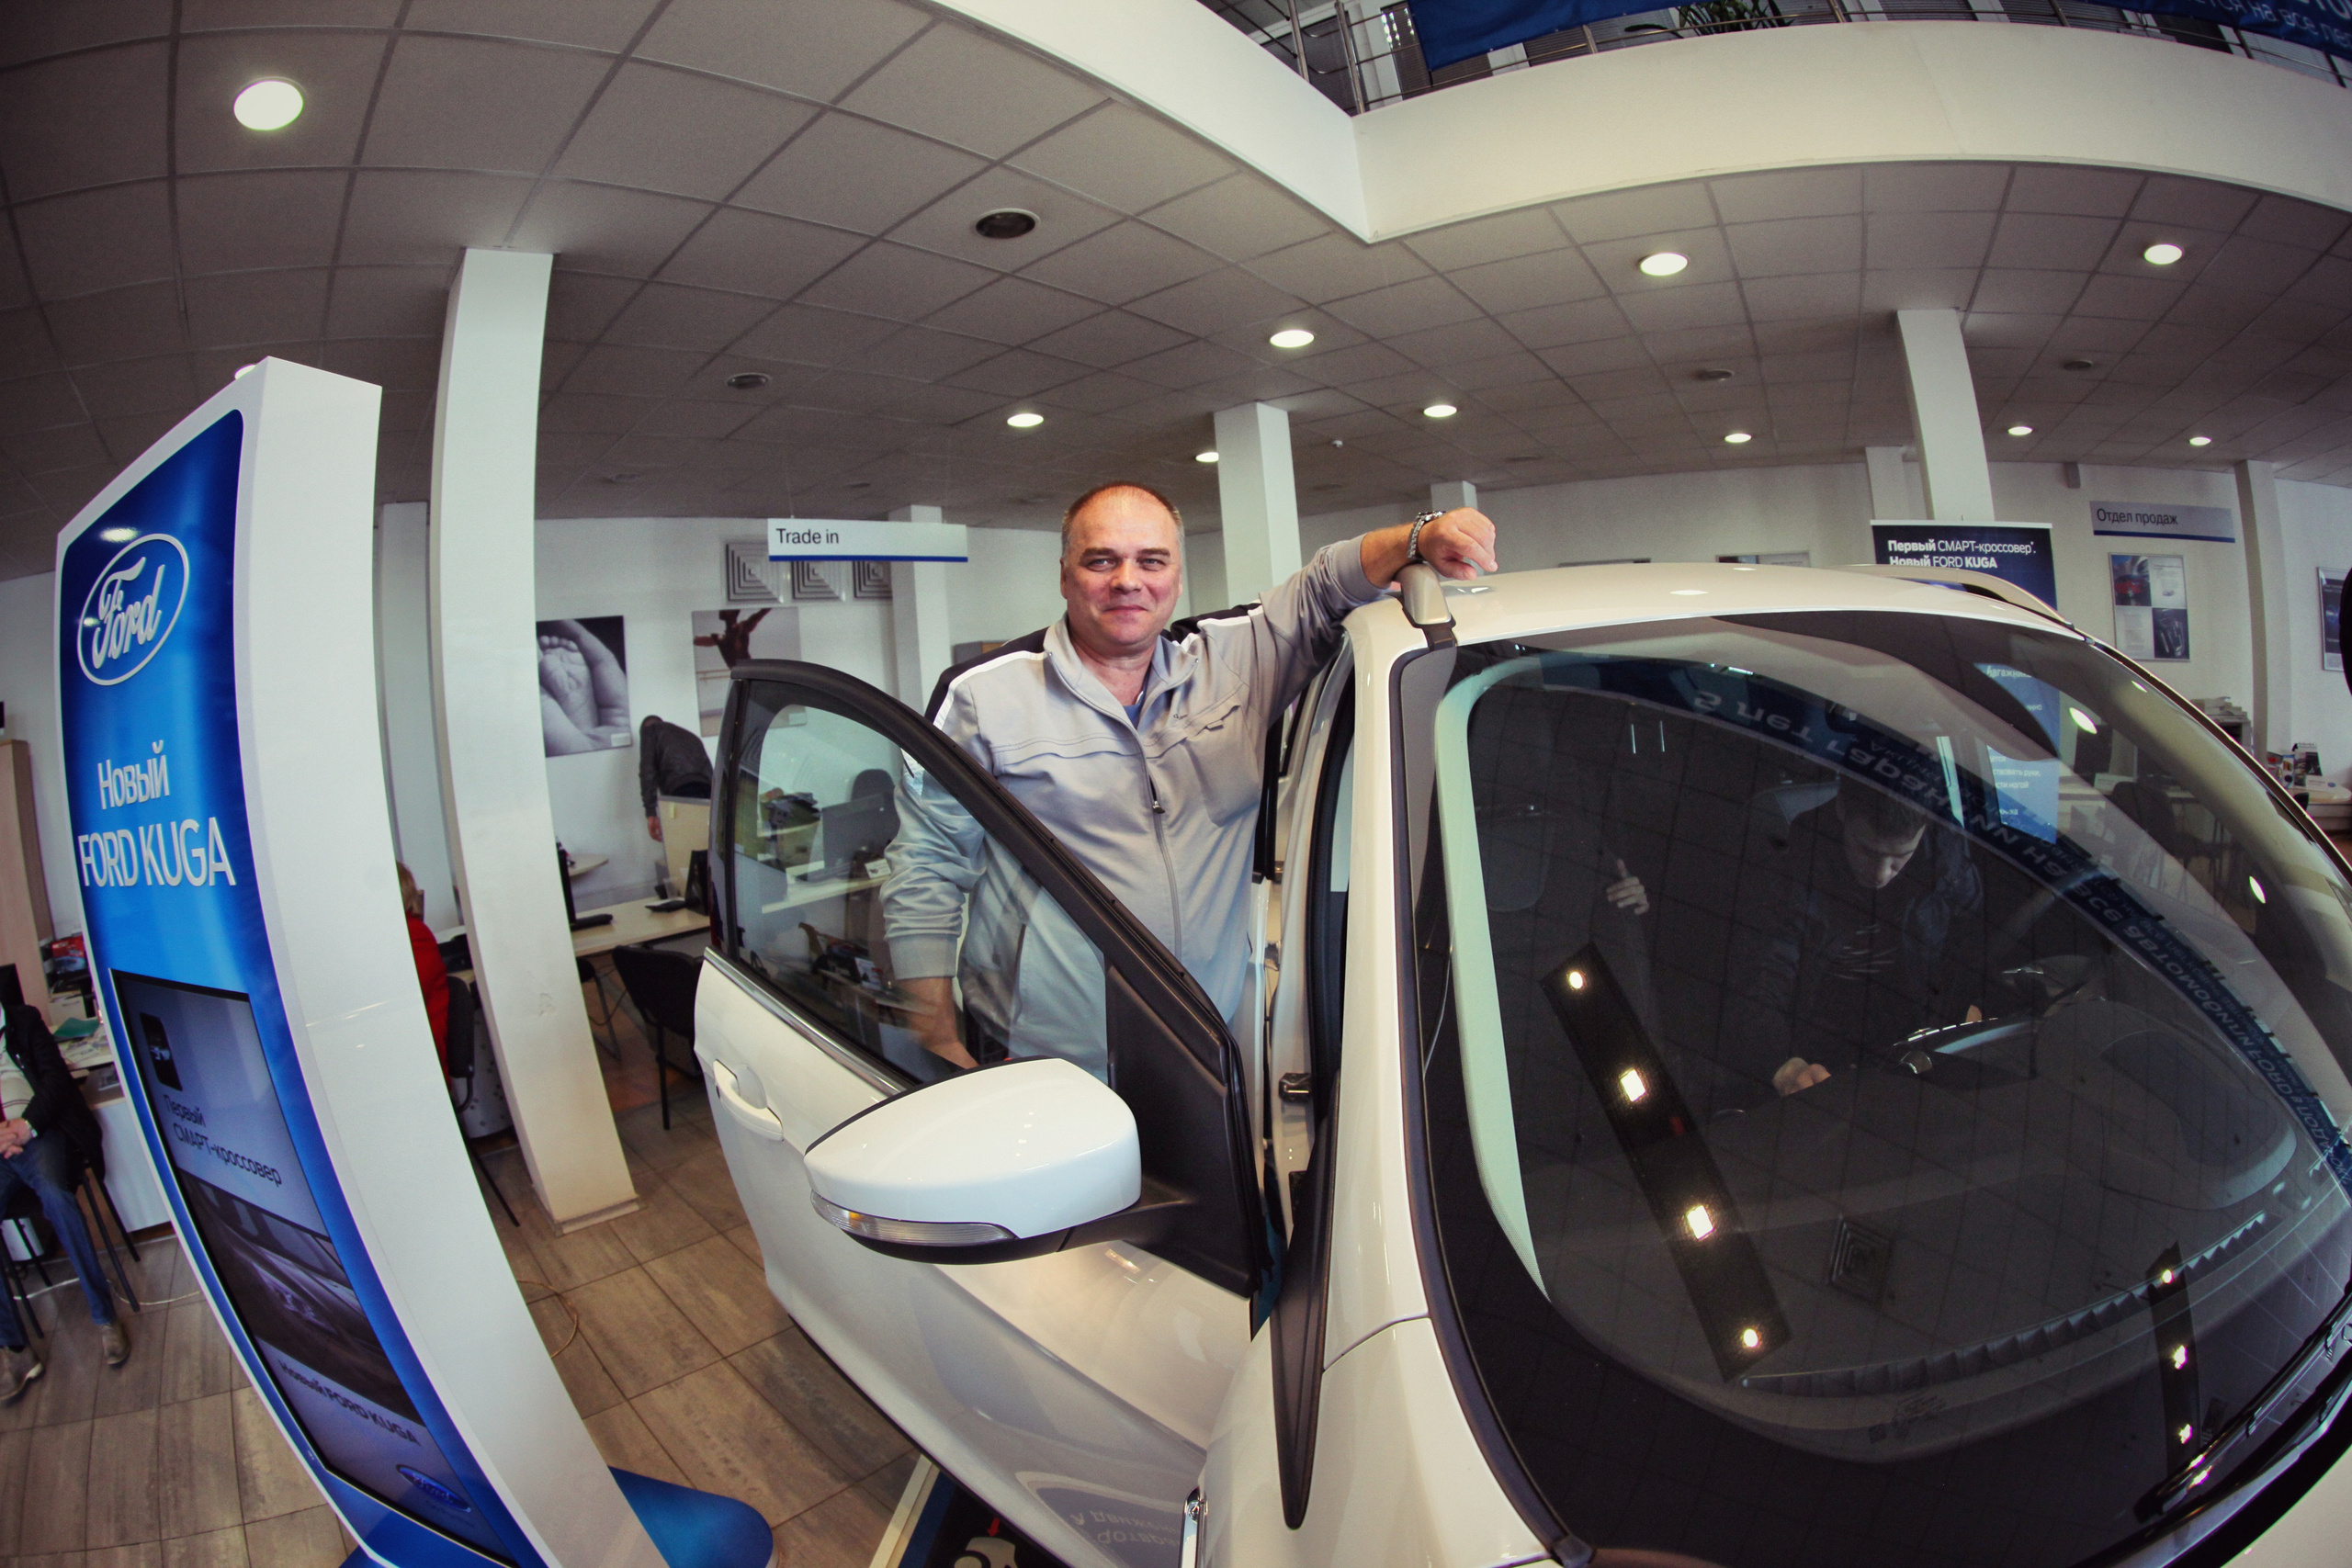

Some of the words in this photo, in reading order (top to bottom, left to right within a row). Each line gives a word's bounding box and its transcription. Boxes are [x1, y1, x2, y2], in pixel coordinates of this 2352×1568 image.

[775, 528, 821, 544] Trade
[825, 529, 840, 544] in
[2097, 508, 2132, 524] Отдел
[2135, 513, 2178, 526] продаж
[1888, 538, 1937, 553] Первый
[1889, 555, 1931, 566] Новый
[1932, 556, 1962, 568] FORD
[1964, 557, 1998, 569] KUGA
[92, 557, 165, 669] Ford
[98, 739, 170, 810] Новый
[78, 829, 140, 886] FORD
[139, 817, 236, 886] KUGA
[163, 1094, 206, 1127] Первый
[173, 1122, 282, 1187] СМАРТ-кроссовер
[324, 1386, 369, 1420] FORD
[368, 1410, 421, 1447] KUGA
